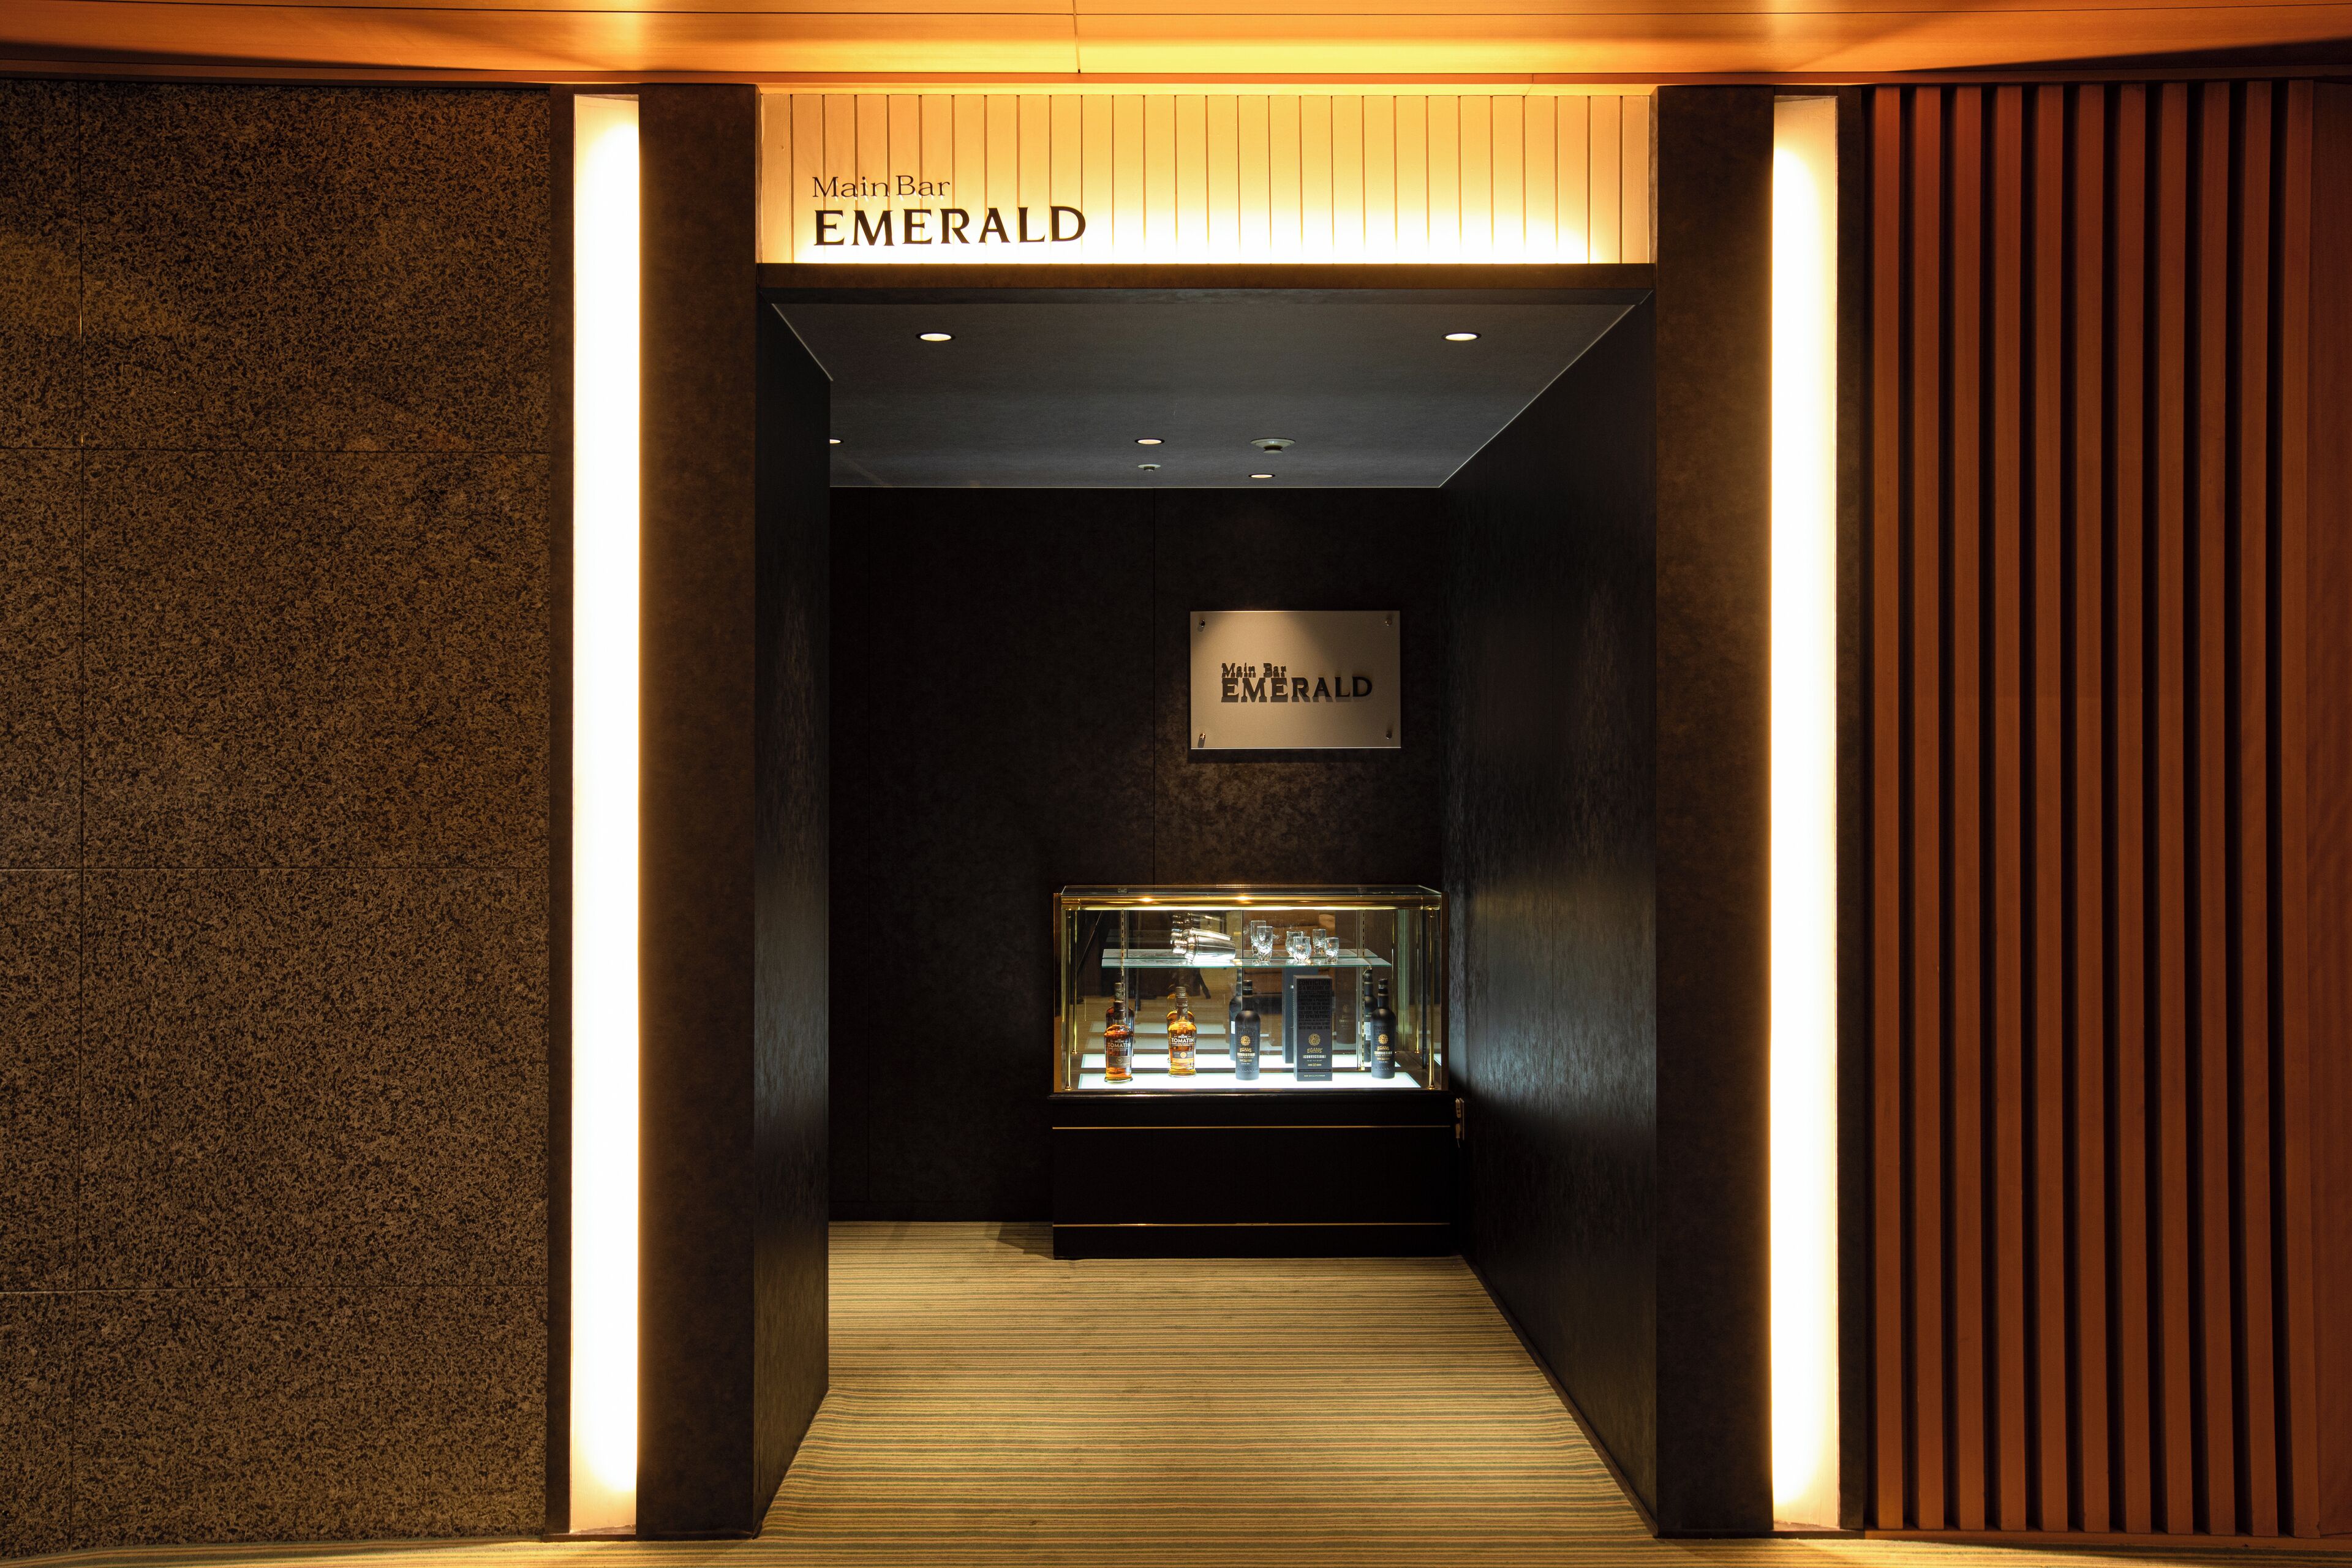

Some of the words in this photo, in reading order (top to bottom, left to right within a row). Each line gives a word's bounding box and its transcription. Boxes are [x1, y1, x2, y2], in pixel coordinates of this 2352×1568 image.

[812, 176, 889, 198] Main
[895, 175, 950, 197] Bar
[814, 205, 1086, 246] EMERALD
[1221, 663, 1256, 677] Main
[1263, 663, 1287, 677] Bar
[1221, 676, 1373, 700] EMERALD
